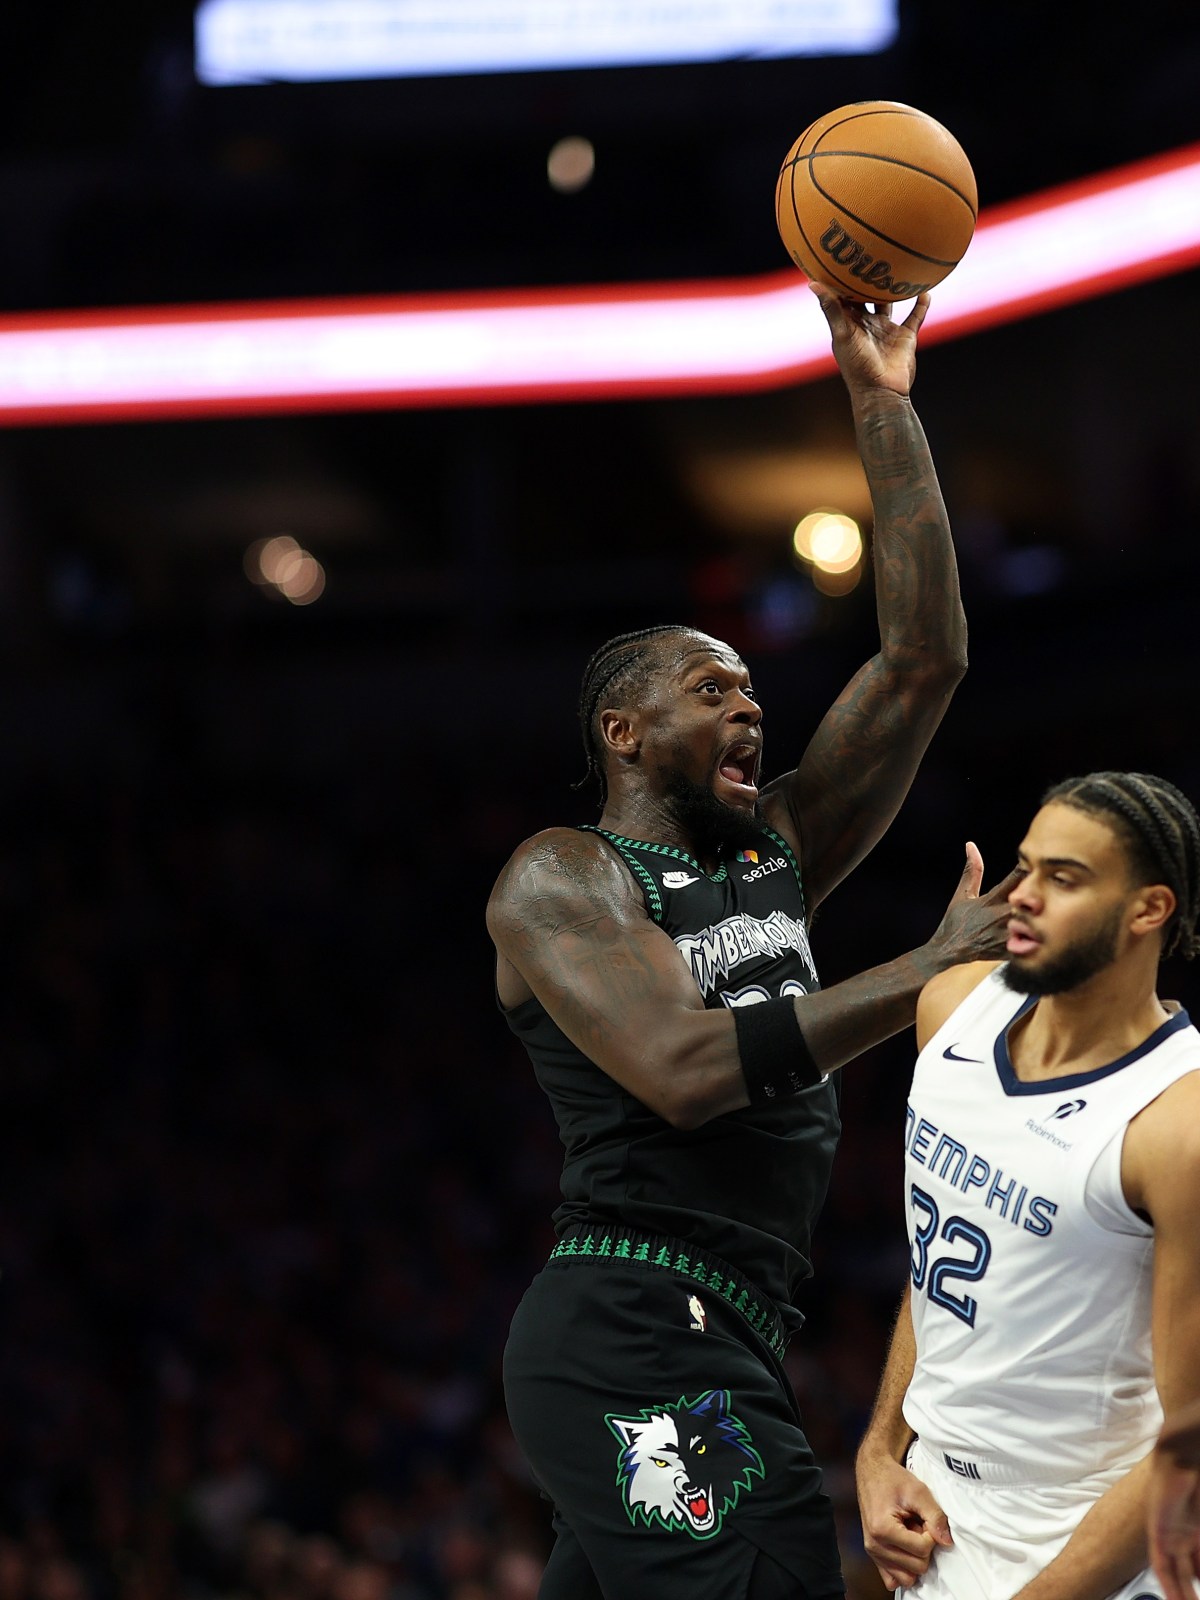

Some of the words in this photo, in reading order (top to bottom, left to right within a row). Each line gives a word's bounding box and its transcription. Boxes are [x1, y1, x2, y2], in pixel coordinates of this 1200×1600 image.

[819, 218, 931, 297] Wilson
[741, 856, 788, 883] sezzle
[911, 1183, 992, 1330] 32
